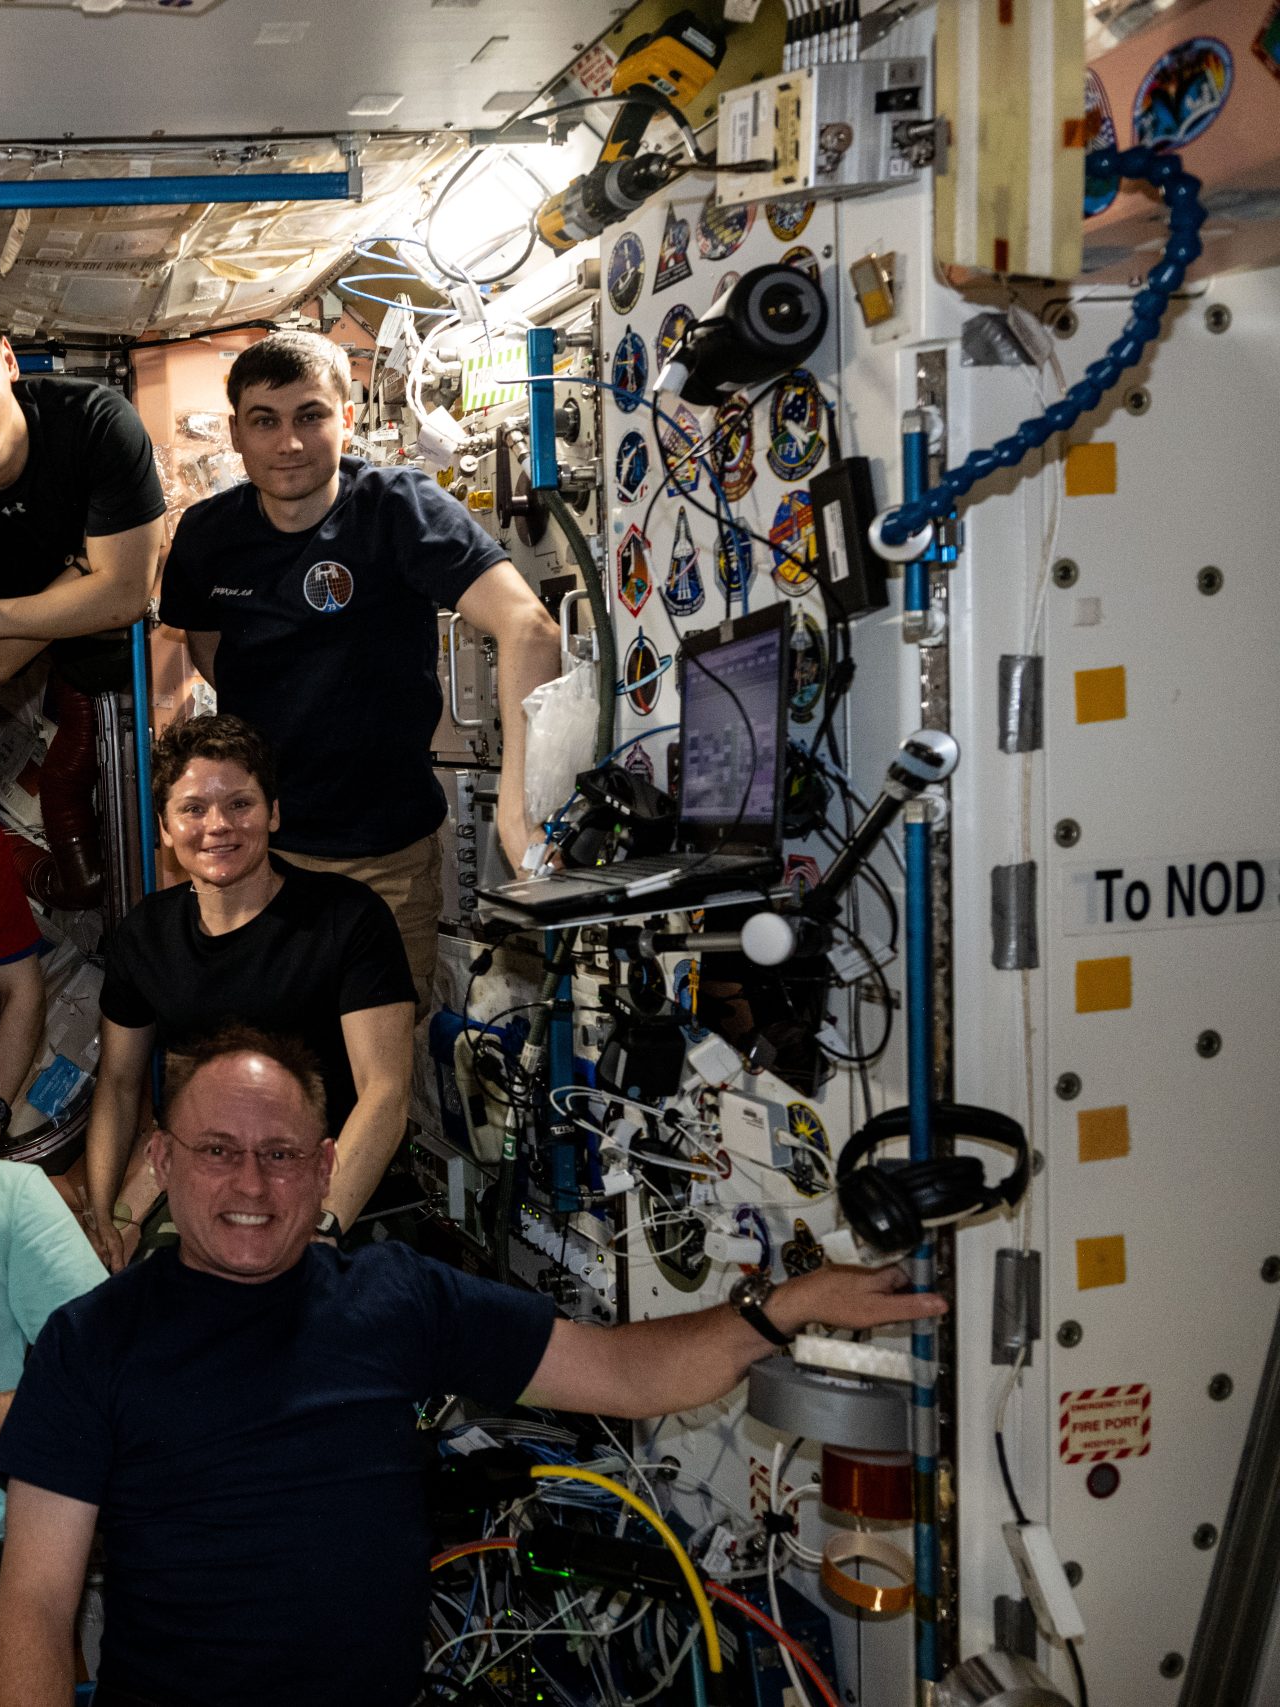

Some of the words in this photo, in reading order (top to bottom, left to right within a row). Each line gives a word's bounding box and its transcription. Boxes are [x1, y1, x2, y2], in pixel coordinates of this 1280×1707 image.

[327, 603, 337, 611] 73
[1095, 869, 1151, 923] To
[1167, 860, 1280, 918] NOD
[1072, 1420, 1100, 1434] FIRE
[1104, 1416, 1140, 1430] PORT
